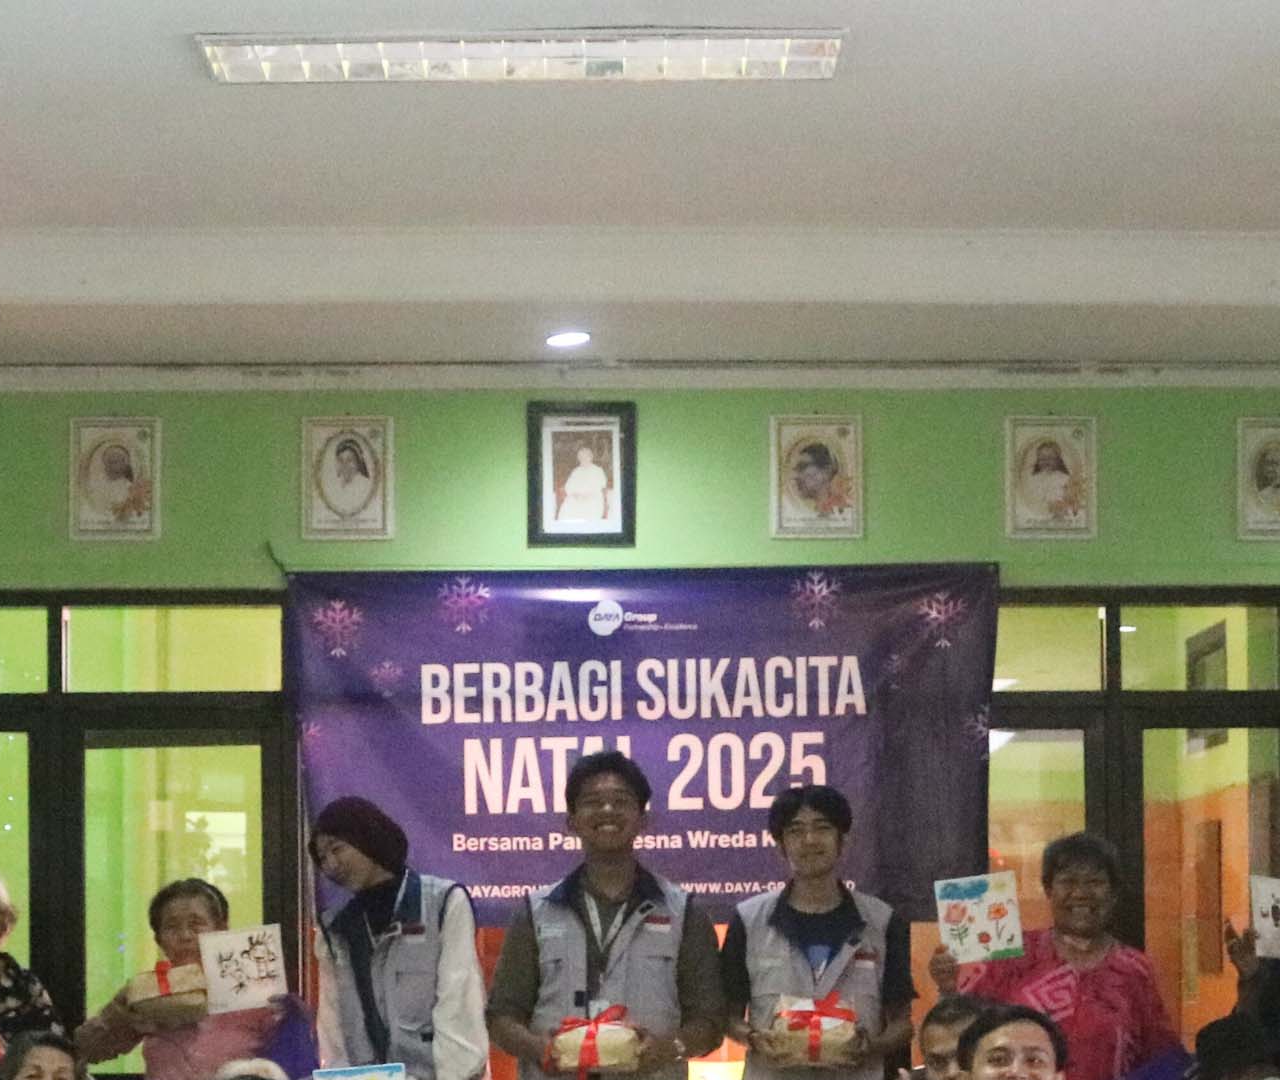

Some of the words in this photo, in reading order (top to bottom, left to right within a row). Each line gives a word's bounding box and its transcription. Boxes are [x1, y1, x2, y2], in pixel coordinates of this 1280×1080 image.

[624, 611, 658, 625] Group
[420, 659, 623, 724] BERBAGI
[636, 656, 867, 720] SUKACITA
[666, 731, 827, 812] 2025
[452, 833, 544, 851] Bersama
[632, 833, 682, 850] esna
[686, 830, 757, 848] Wreda
